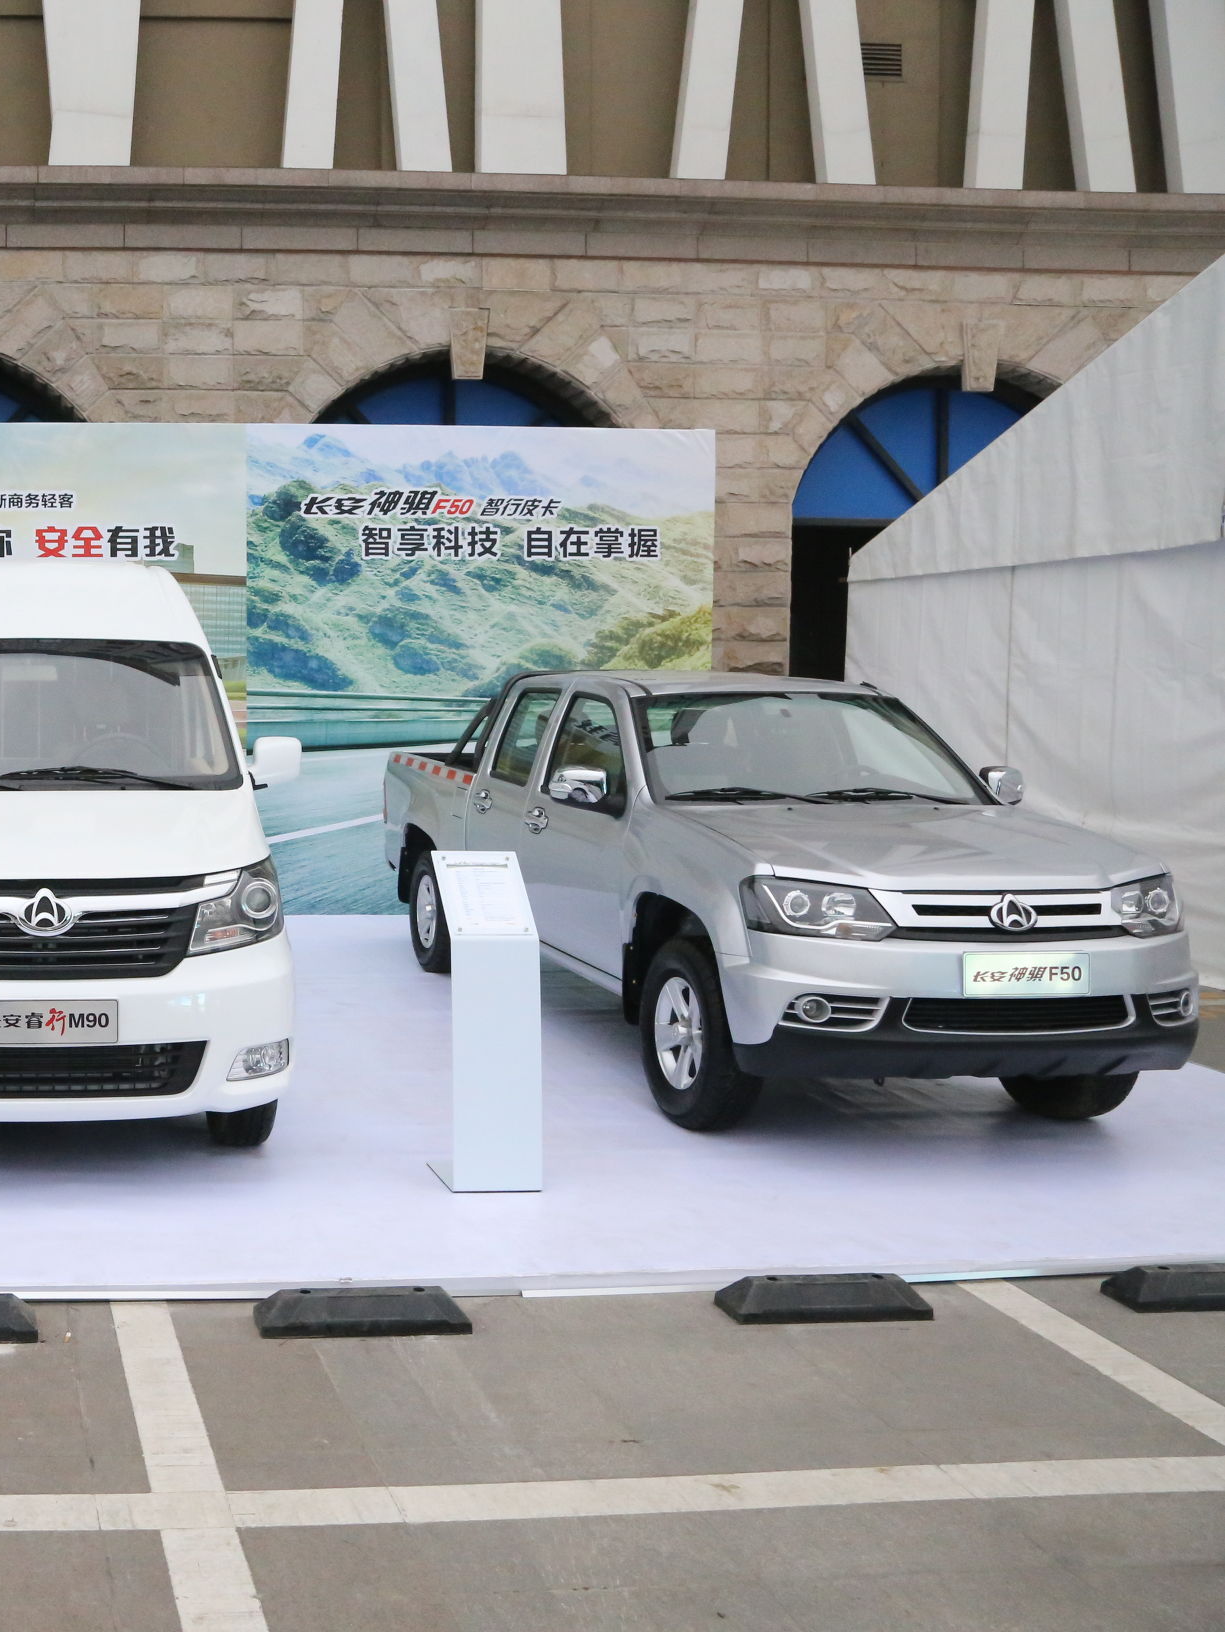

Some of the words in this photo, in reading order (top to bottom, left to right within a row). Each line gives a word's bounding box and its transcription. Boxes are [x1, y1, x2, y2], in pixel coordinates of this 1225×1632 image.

[480, 498, 562, 517] 智行皮卡
[35, 525, 176, 558] 安全有我
[361, 525, 500, 559] 智享科技
[526, 526, 659, 559] 自在掌握
